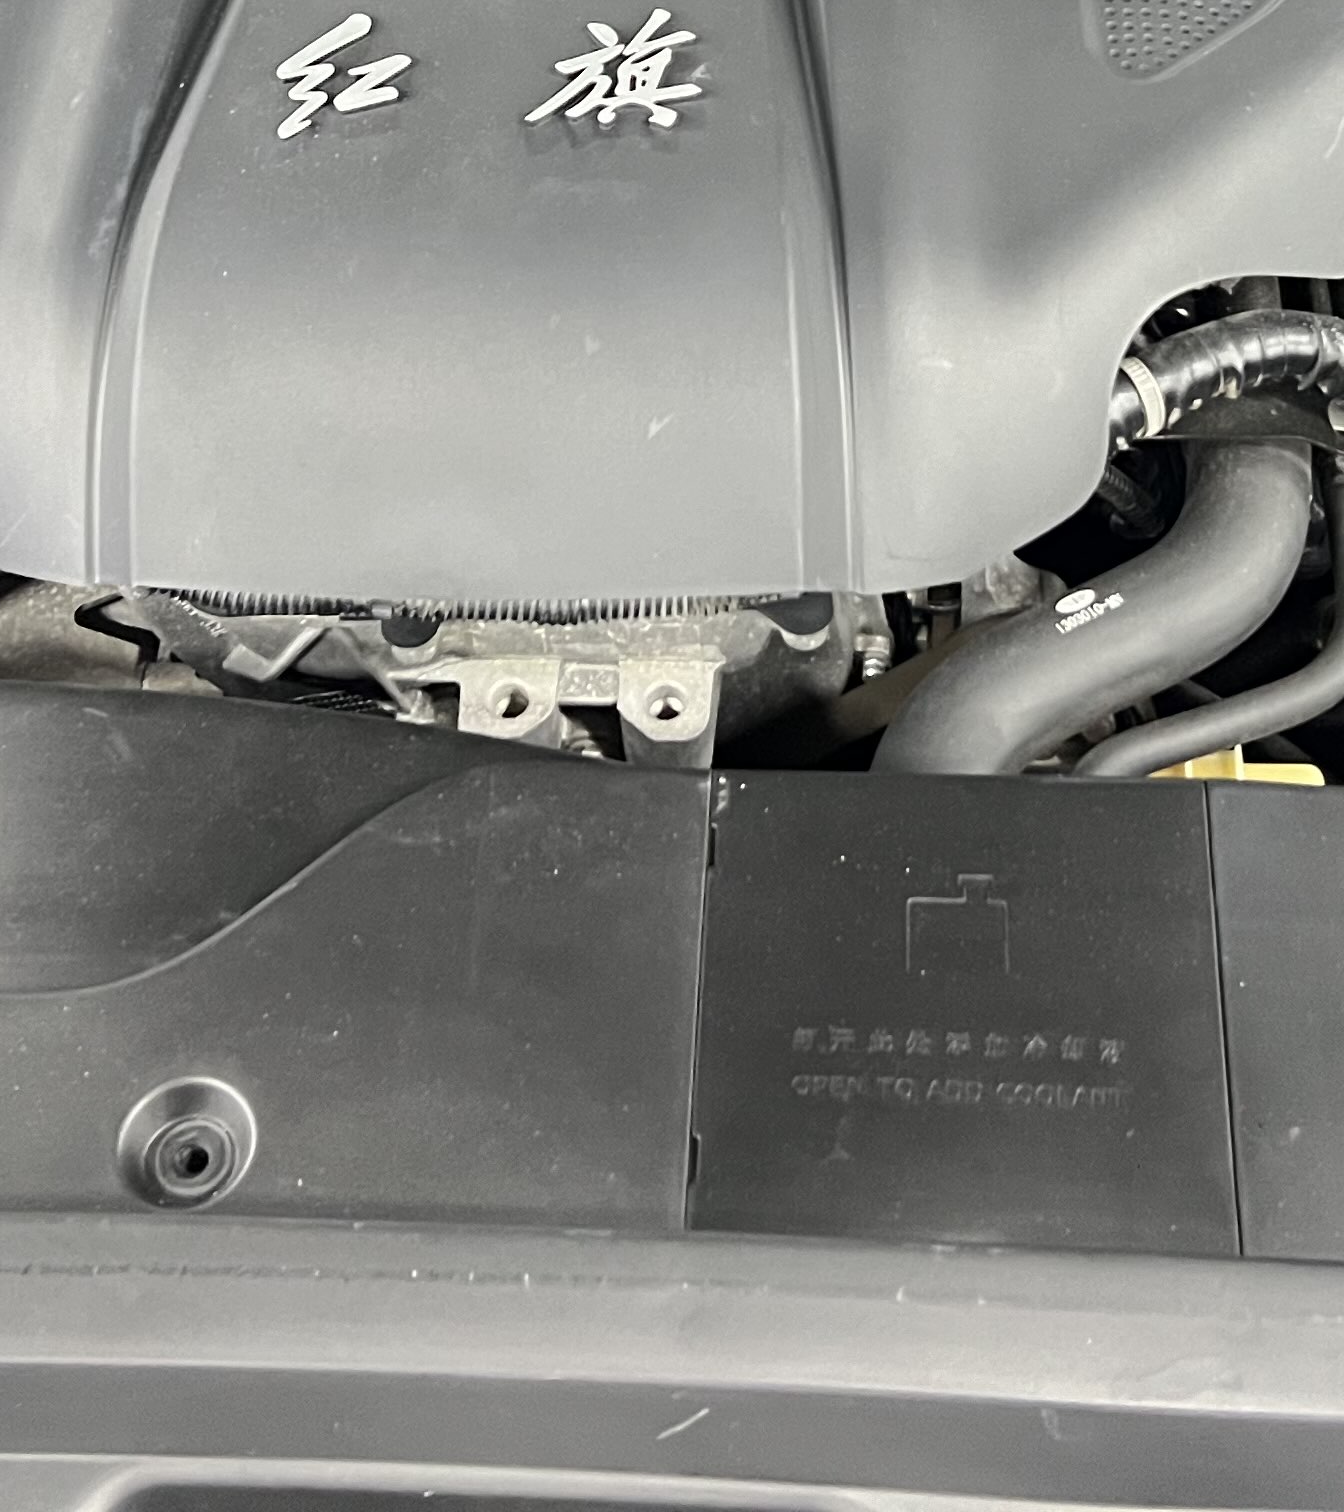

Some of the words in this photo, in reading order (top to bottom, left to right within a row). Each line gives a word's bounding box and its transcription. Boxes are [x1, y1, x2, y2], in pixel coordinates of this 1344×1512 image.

[791, 1074, 866, 1100] OPEN
[877, 1076, 915, 1102] TO
[925, 1078, 984, 1105] ADD
[995, 1082, 1131, 1109] COOLANT
